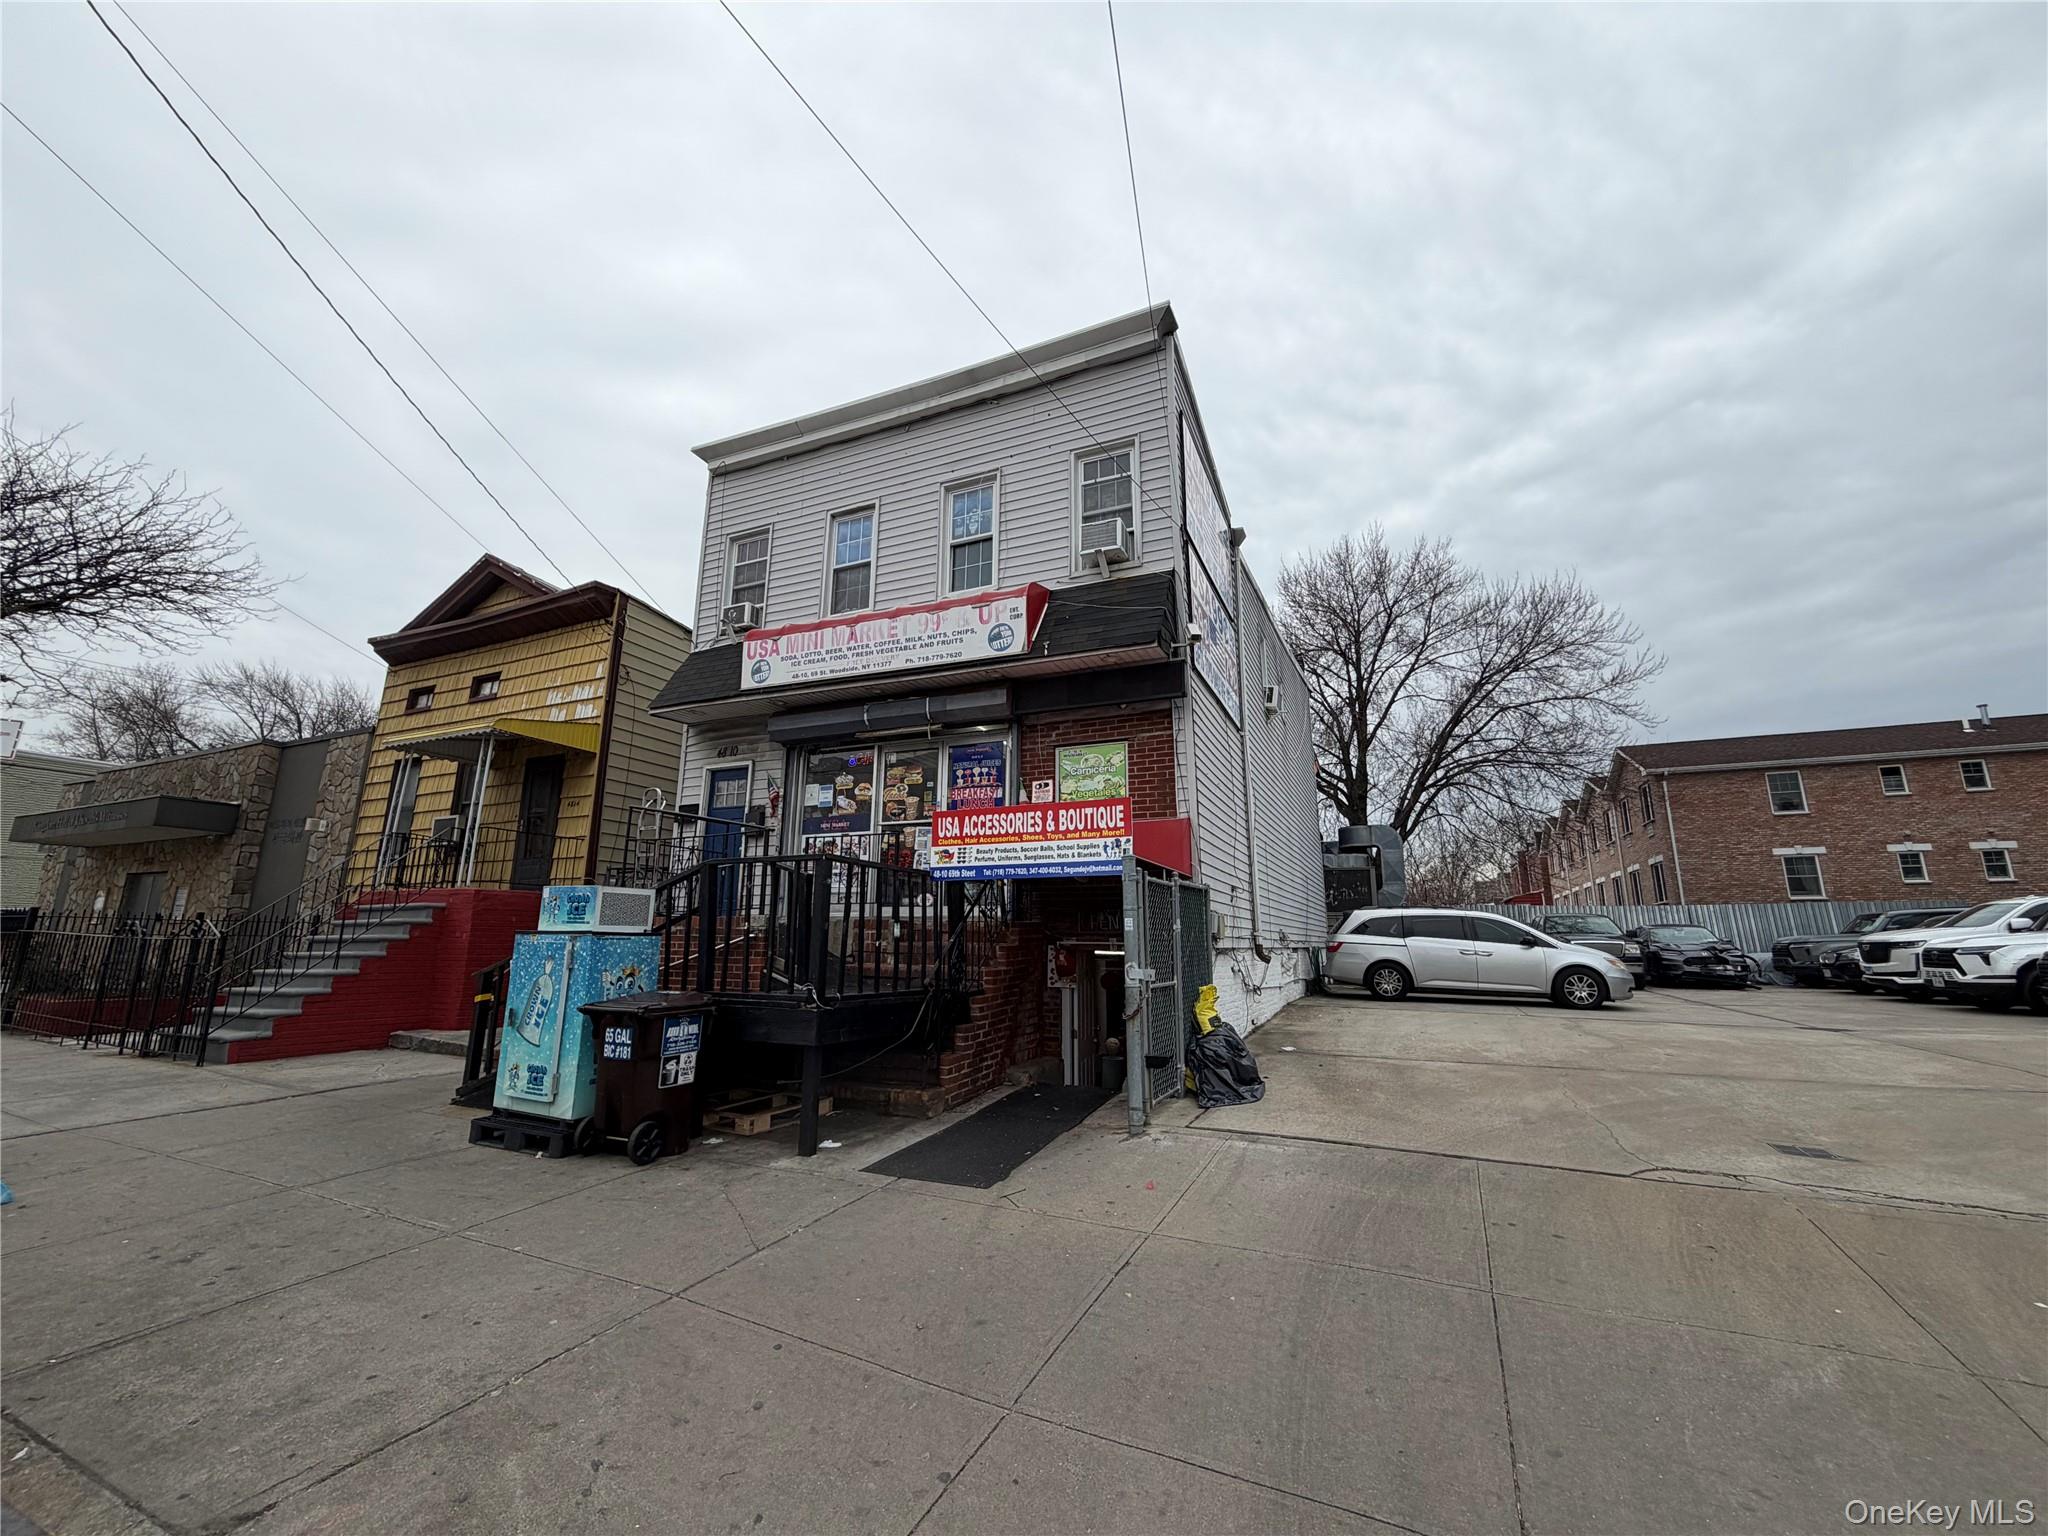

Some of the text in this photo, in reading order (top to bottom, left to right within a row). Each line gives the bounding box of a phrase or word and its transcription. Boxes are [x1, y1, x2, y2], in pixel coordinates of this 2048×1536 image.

[747, 640, 780, 660] USA
[785, 631, 825, 655] MINI
[831, 616, 909, 647] MARKET
[979, 603, 1008, 625] UP
[781, 627, 978, 662] SODA, LOTTO, BEER, WATER, COFFEE, MILK, NUTS, CHIPS,
[803, 656, 828, 667] CREAM,
[829, 653, 850, 662] FOOD,
[852, 650, 874, 659] FRESH
[876, 644, 920, 656] VEGETABLE
[920, 640, 935, 649] AND
[936, 636, 964, 647] FRUITS
[829, 666, 861, 675] Woodside,
[861, 663, 871, 671] NY
[873, 660, 892, 669] 11377
[1071, 788, 1117, 799] Vegetales
[959, 798, 995, 810] LUNCH
[938, 816, 960, 838] USA
[962, 810, 1043, 837] ACCESSORIES
[1046, 810, 1055, 832] &
[1058, 804, 1125, 831] BOUTIQUE
[938, 838, 964, 846] Clothes,
[979, 835, 1021, 844] Accessories,
[1022, 833, 1045, 841] Shoes,
[1047, 832, 1065, 840] Toys,
[1081, 829, 1100, 839] Many
[1102, 828, 1125, 836] More!!
[974, 855, 997, 863] Perfume,
[997, 854, 1023, 863] Uniforms,
[1024, 853, 1056, 862] Sunglasses,
[1071, 851, 1076, 859] &
[1077, 850, 1102, 859] Blankets
[976, 842, 1101, 856] Beauty Products, Soccer Balls, School Supplies
[933, 869, 948, 879] 48-10
[992, 867, 1005, 877] (718)
[566, 902, 587, 916] ICE
[525, 986, 542, 1026] CROWN
[533, 997, 549, 1029] ICE
[605, 1028, 632, 1044] 65 GAL
[603, 1044, 632, 1059] BIC #181
[526, 1072, 545, 1087] ICE
